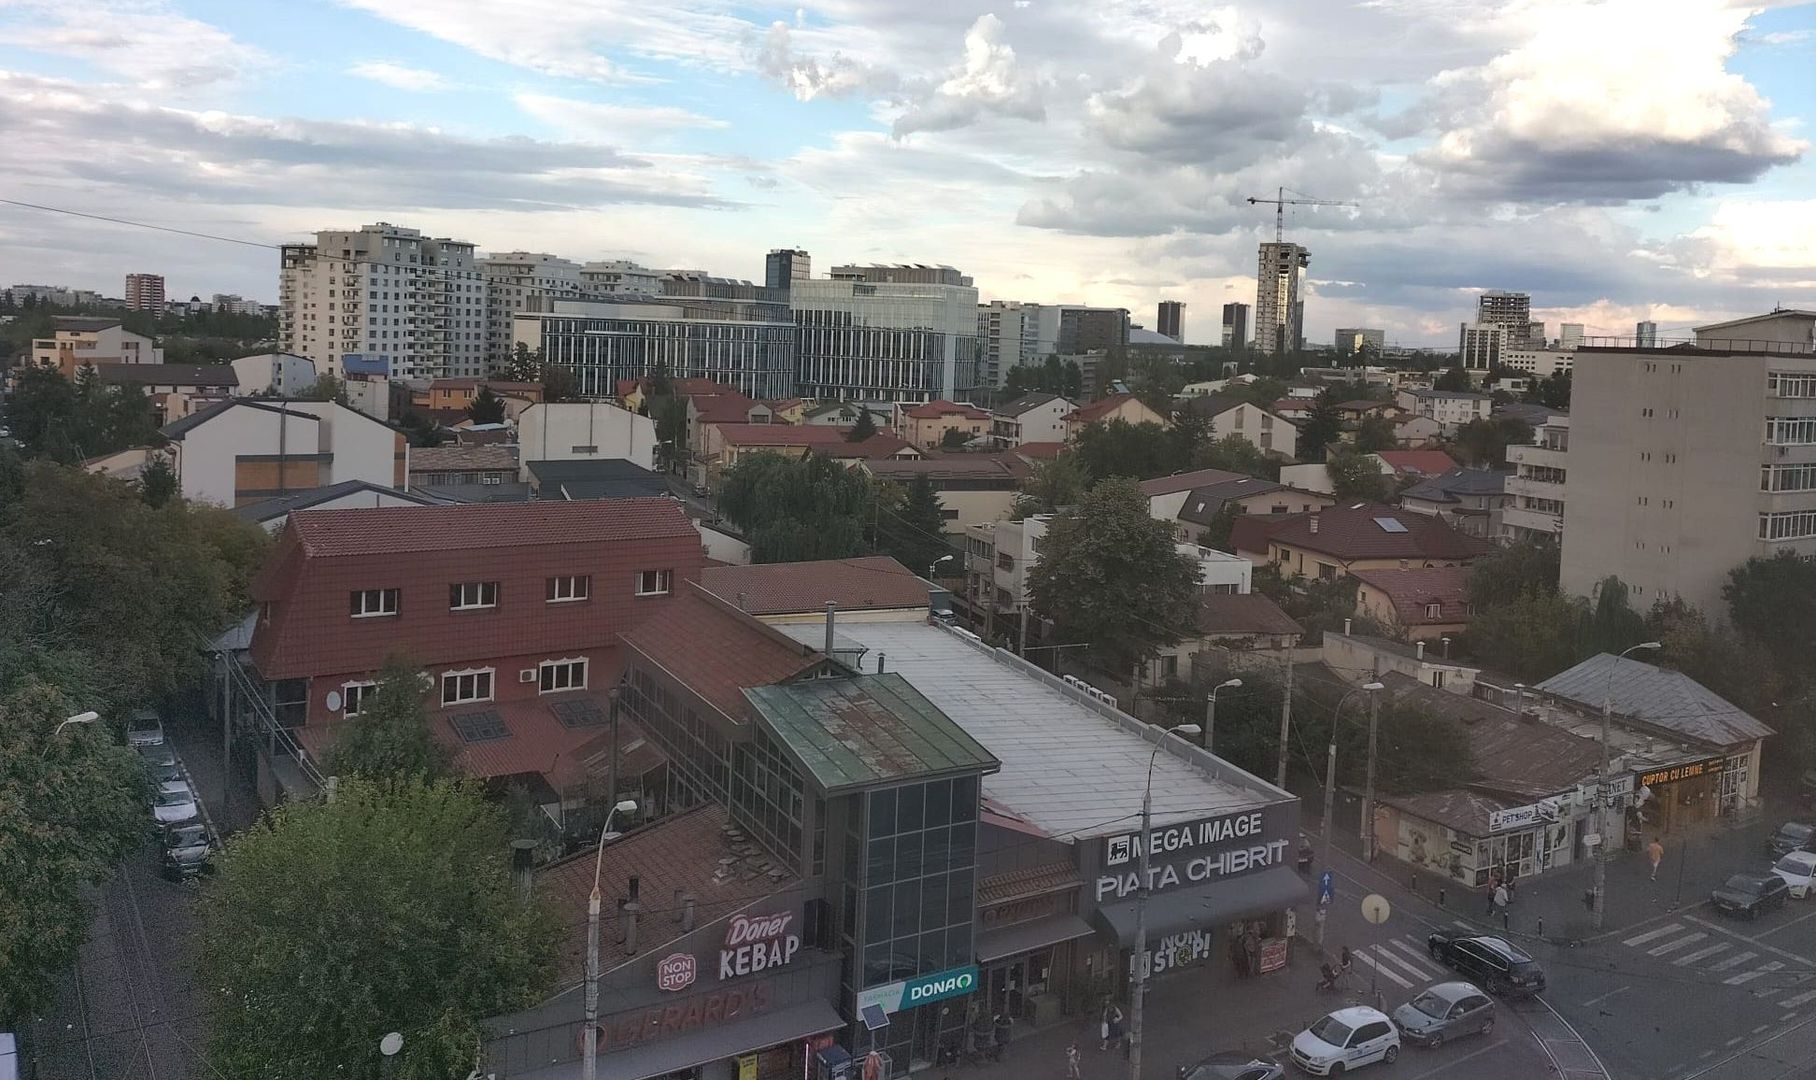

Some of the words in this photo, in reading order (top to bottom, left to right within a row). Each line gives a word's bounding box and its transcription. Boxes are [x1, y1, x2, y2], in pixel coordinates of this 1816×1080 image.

[1642, 771, 1668, 786] CUPTOR
[1670, 768, 1680, 780] CU
[1680, 763, 1703, 778] LEMNE
[1132, 826, 1194, 858] MEGA
[1198, 812, 1262, 845] IMAGE
[1096, 864, 1180, 902] PIATA
[1186, 838, 1290, 882] CHIBRIT
[728, 914, 793, 945] Doner
[1160, 929, 1202, 951] NON
[663, 959, 692, 975] NON
[719, 935, 800, 981] KEBAP
[663, 972, 692, 987] STOP
